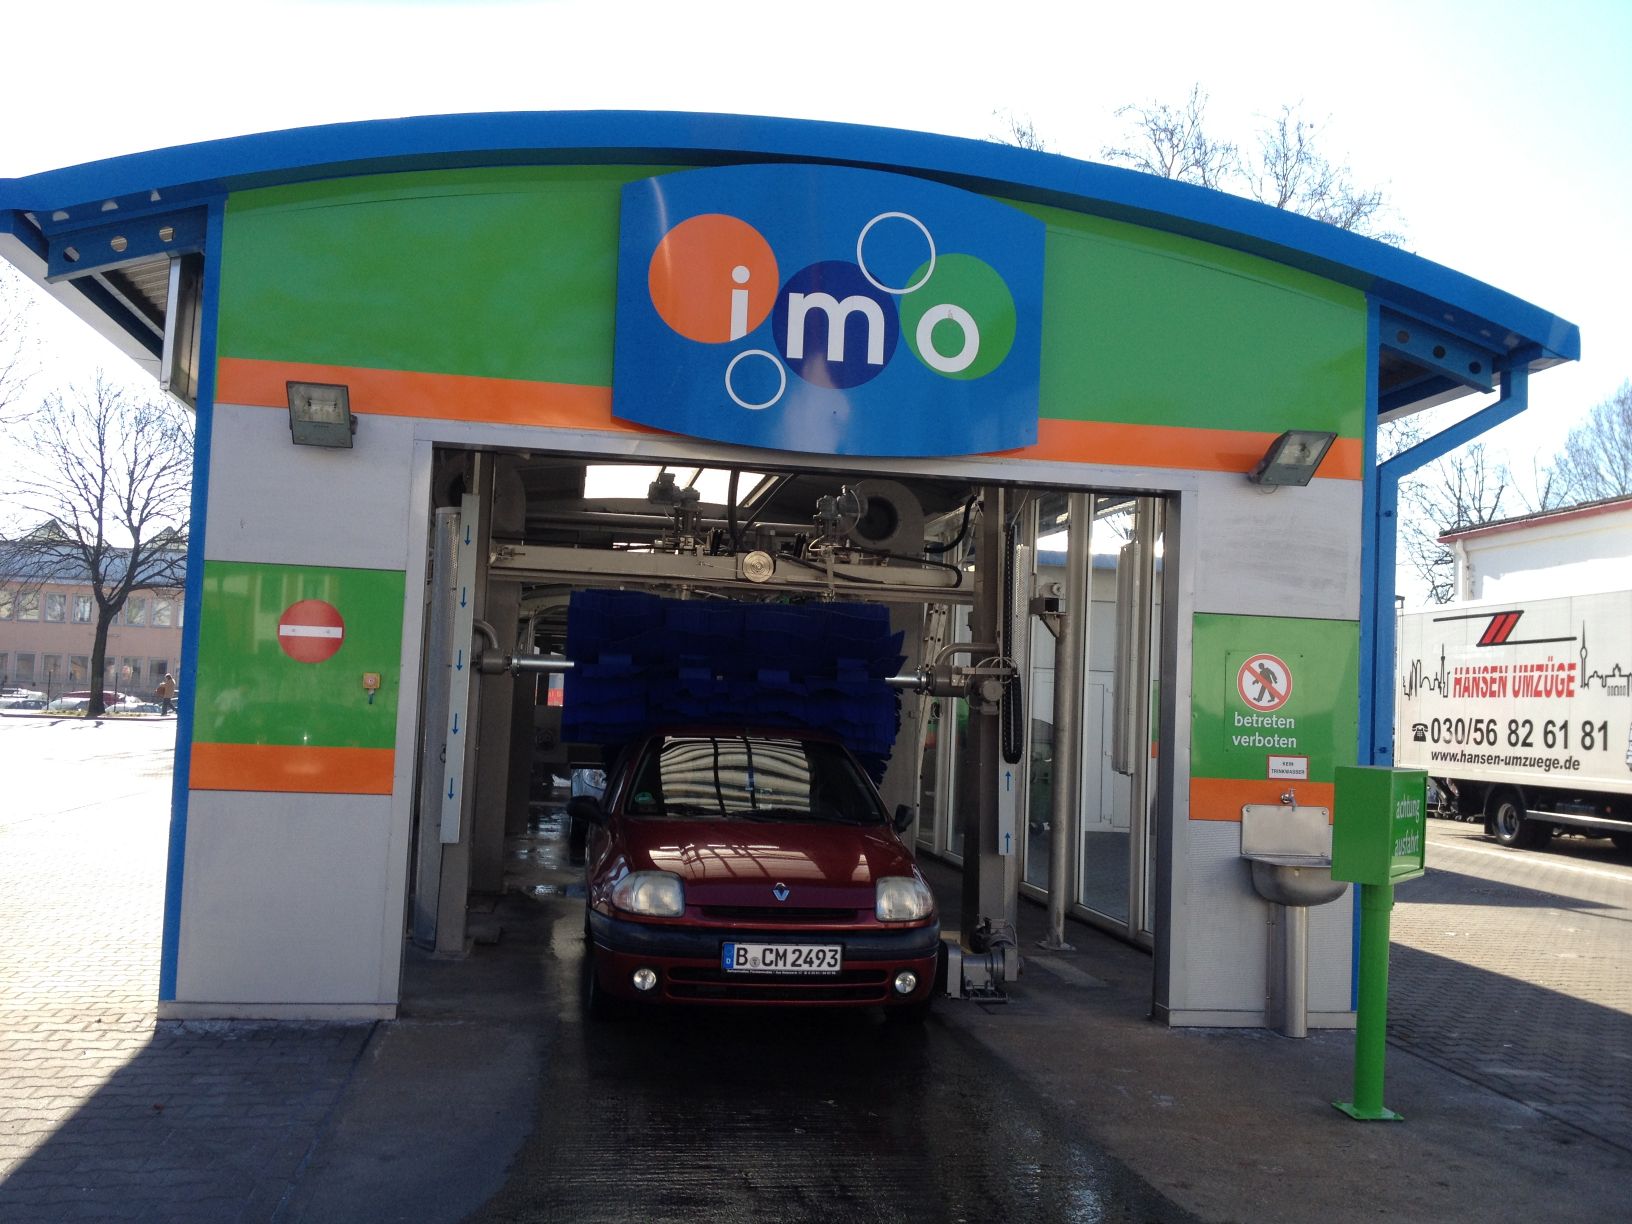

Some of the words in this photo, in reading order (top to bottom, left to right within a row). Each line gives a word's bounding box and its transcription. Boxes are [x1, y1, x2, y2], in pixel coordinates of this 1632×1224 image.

[730, 265, 980, 373] imo
[1453, 665, 1508, 698] HANSEN
[1512, 655, 1577, 698] UMZÜGE
[1234, 711, 1295, 729] betreten
[1431, 717, 1498, 746] 030/56
[1507, 718, 1534, 748] 82
[1543, 719, 1569, 750] 61
[1580, 719, 1609, 751] 81
[1232, 731, 1297, 748] verboten
[1431, 749, 1581, 773] www.hansen-umzuege.de
[1396, 793, 1420, 824] achtung
[1394, 829, 1420, 857] ausfahrt
